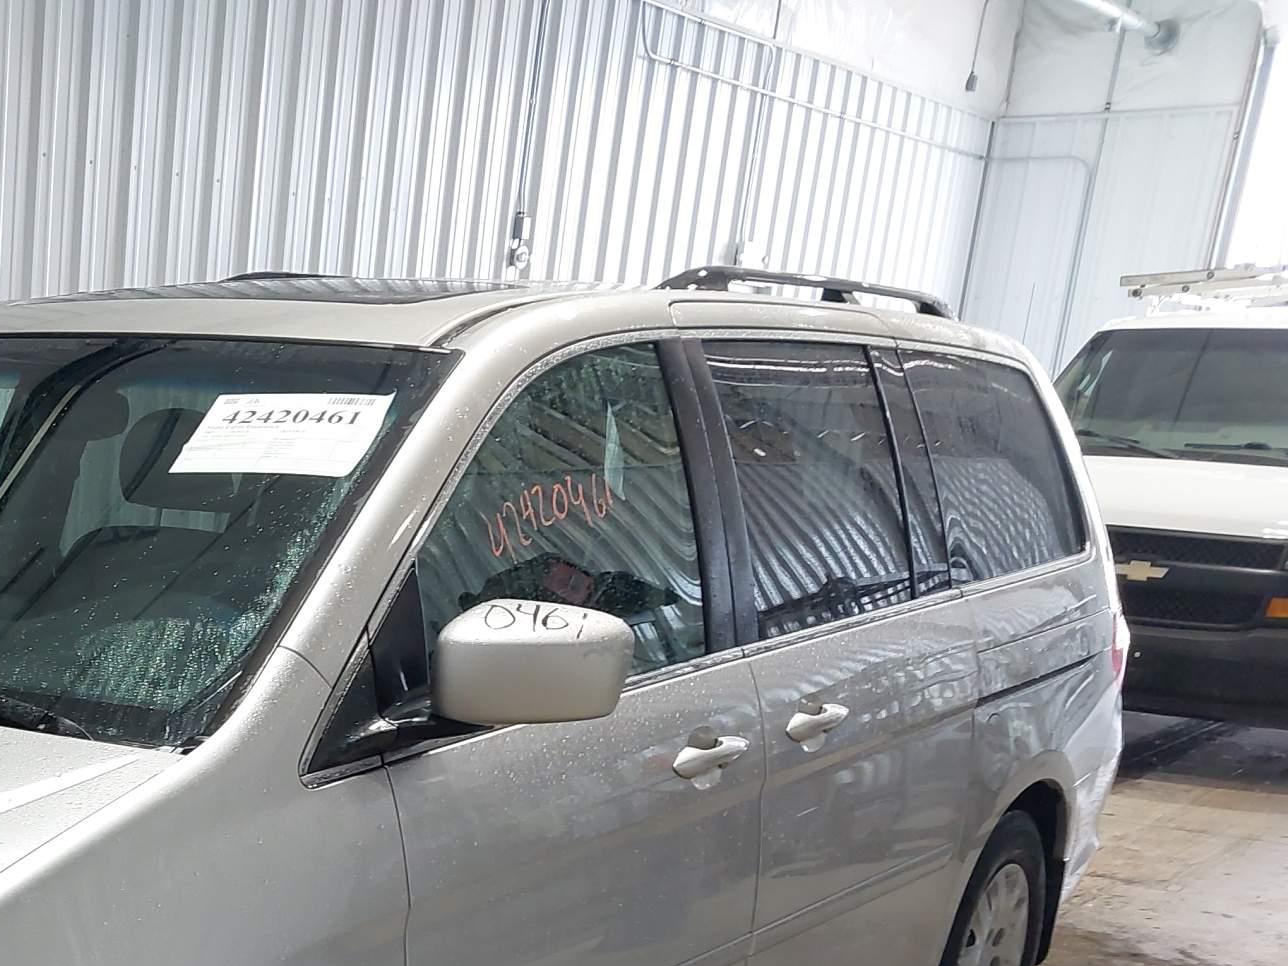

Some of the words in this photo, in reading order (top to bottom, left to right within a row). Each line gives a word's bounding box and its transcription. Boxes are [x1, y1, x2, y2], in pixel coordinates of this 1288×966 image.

[221, 409, 362, 425] 42420461
[479, 473, 614, 565] 42420461
[484, 603, 588, 640] 0461
